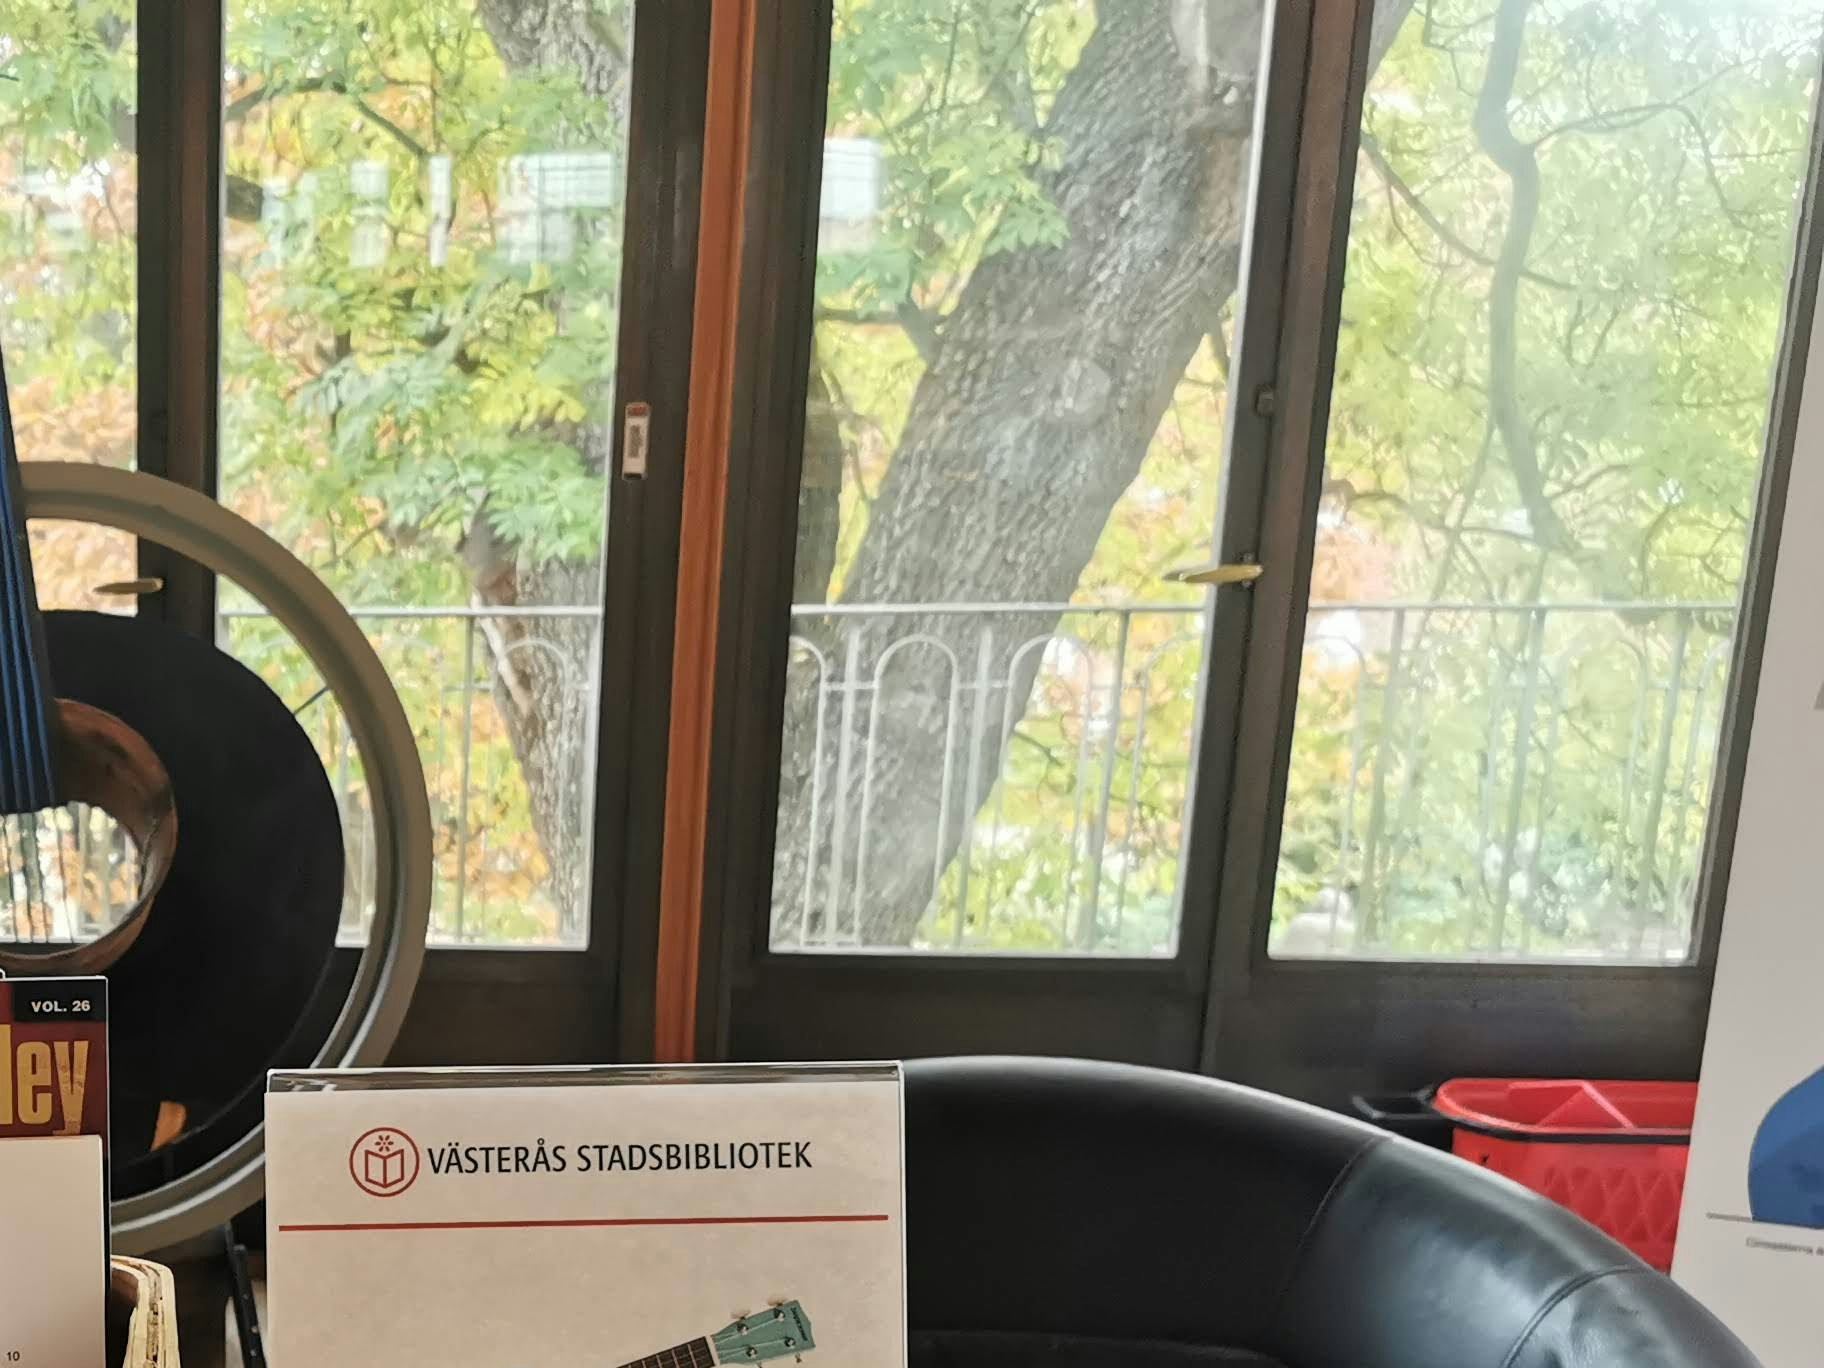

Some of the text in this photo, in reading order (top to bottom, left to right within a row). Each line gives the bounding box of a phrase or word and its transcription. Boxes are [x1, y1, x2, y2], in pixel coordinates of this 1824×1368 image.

[31, 999, 91, 1013] VOL. 26
[427, 1137, 813, 1175] VÄSTERÅS STADSBIBLIOTEK
[7, 1350, 20, 1362] 10
